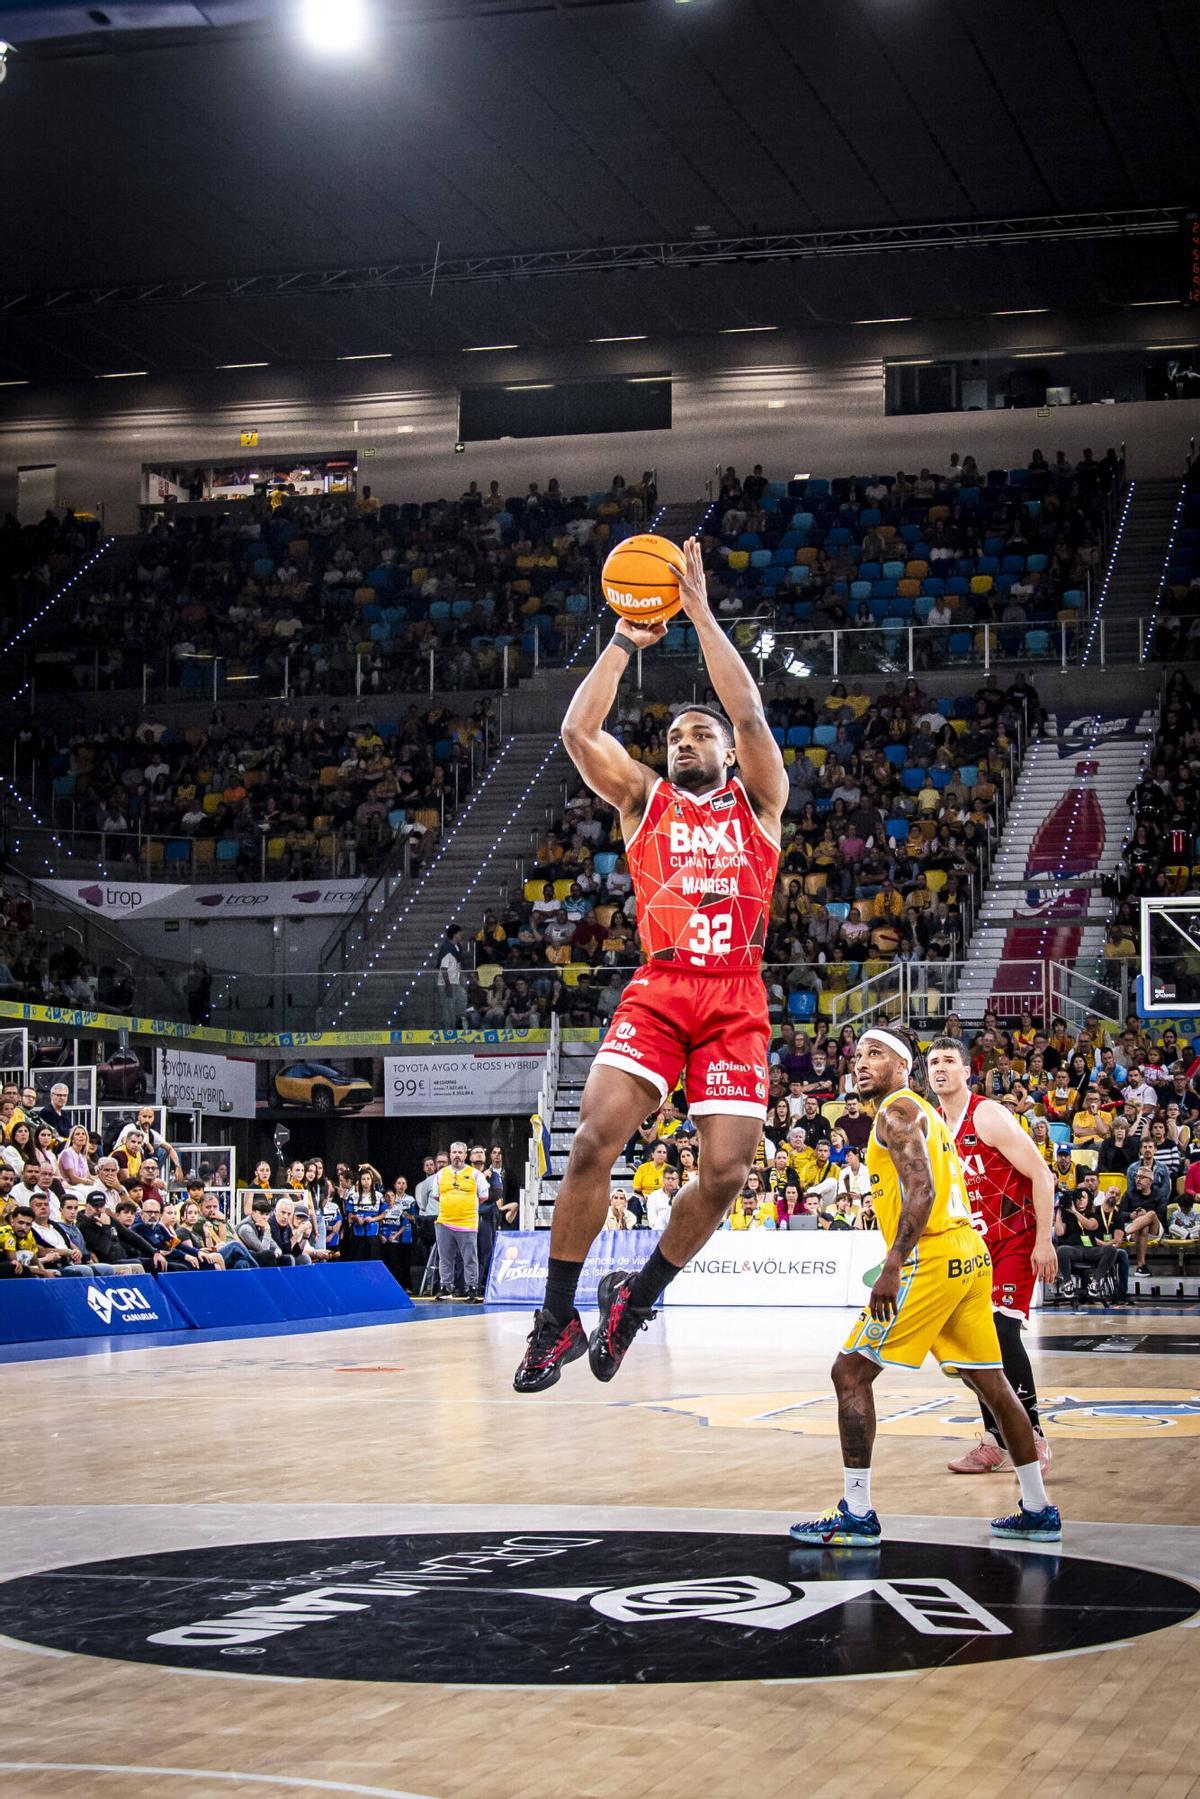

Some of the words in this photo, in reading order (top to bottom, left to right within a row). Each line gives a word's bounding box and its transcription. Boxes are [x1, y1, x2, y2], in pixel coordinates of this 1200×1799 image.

[606, 586, 663, 608] Wilson
[669, 818, 745, 855] BAXI
[106, 887, 142, 909] trop
[225, 894, 269, 904] trop
[689, 913, 733, 954] 32
[194, 1064, 216, 1080] AYGO
[393, 1063, 429, 1073] TOYOTA
[431, 1062, 459, 1072] AYGO
[461, 1062, 468, 1071] X
[470, 1060, 501, 1071] CROSS
[504, 1060, 539, 1070] HYBRID
[706, 1073, 731, 1085] ETL
[197, 1087, 225, 1103] HYBRID
[705, 1086, 751, 1097] GLOBAL
[584, 1257, 614, 1266] gencia
[617, 1256, 629, 1265] de
[105, 1287, 151, 1311] CRI
[121, 1312, 159, 1322] CANARIAS
